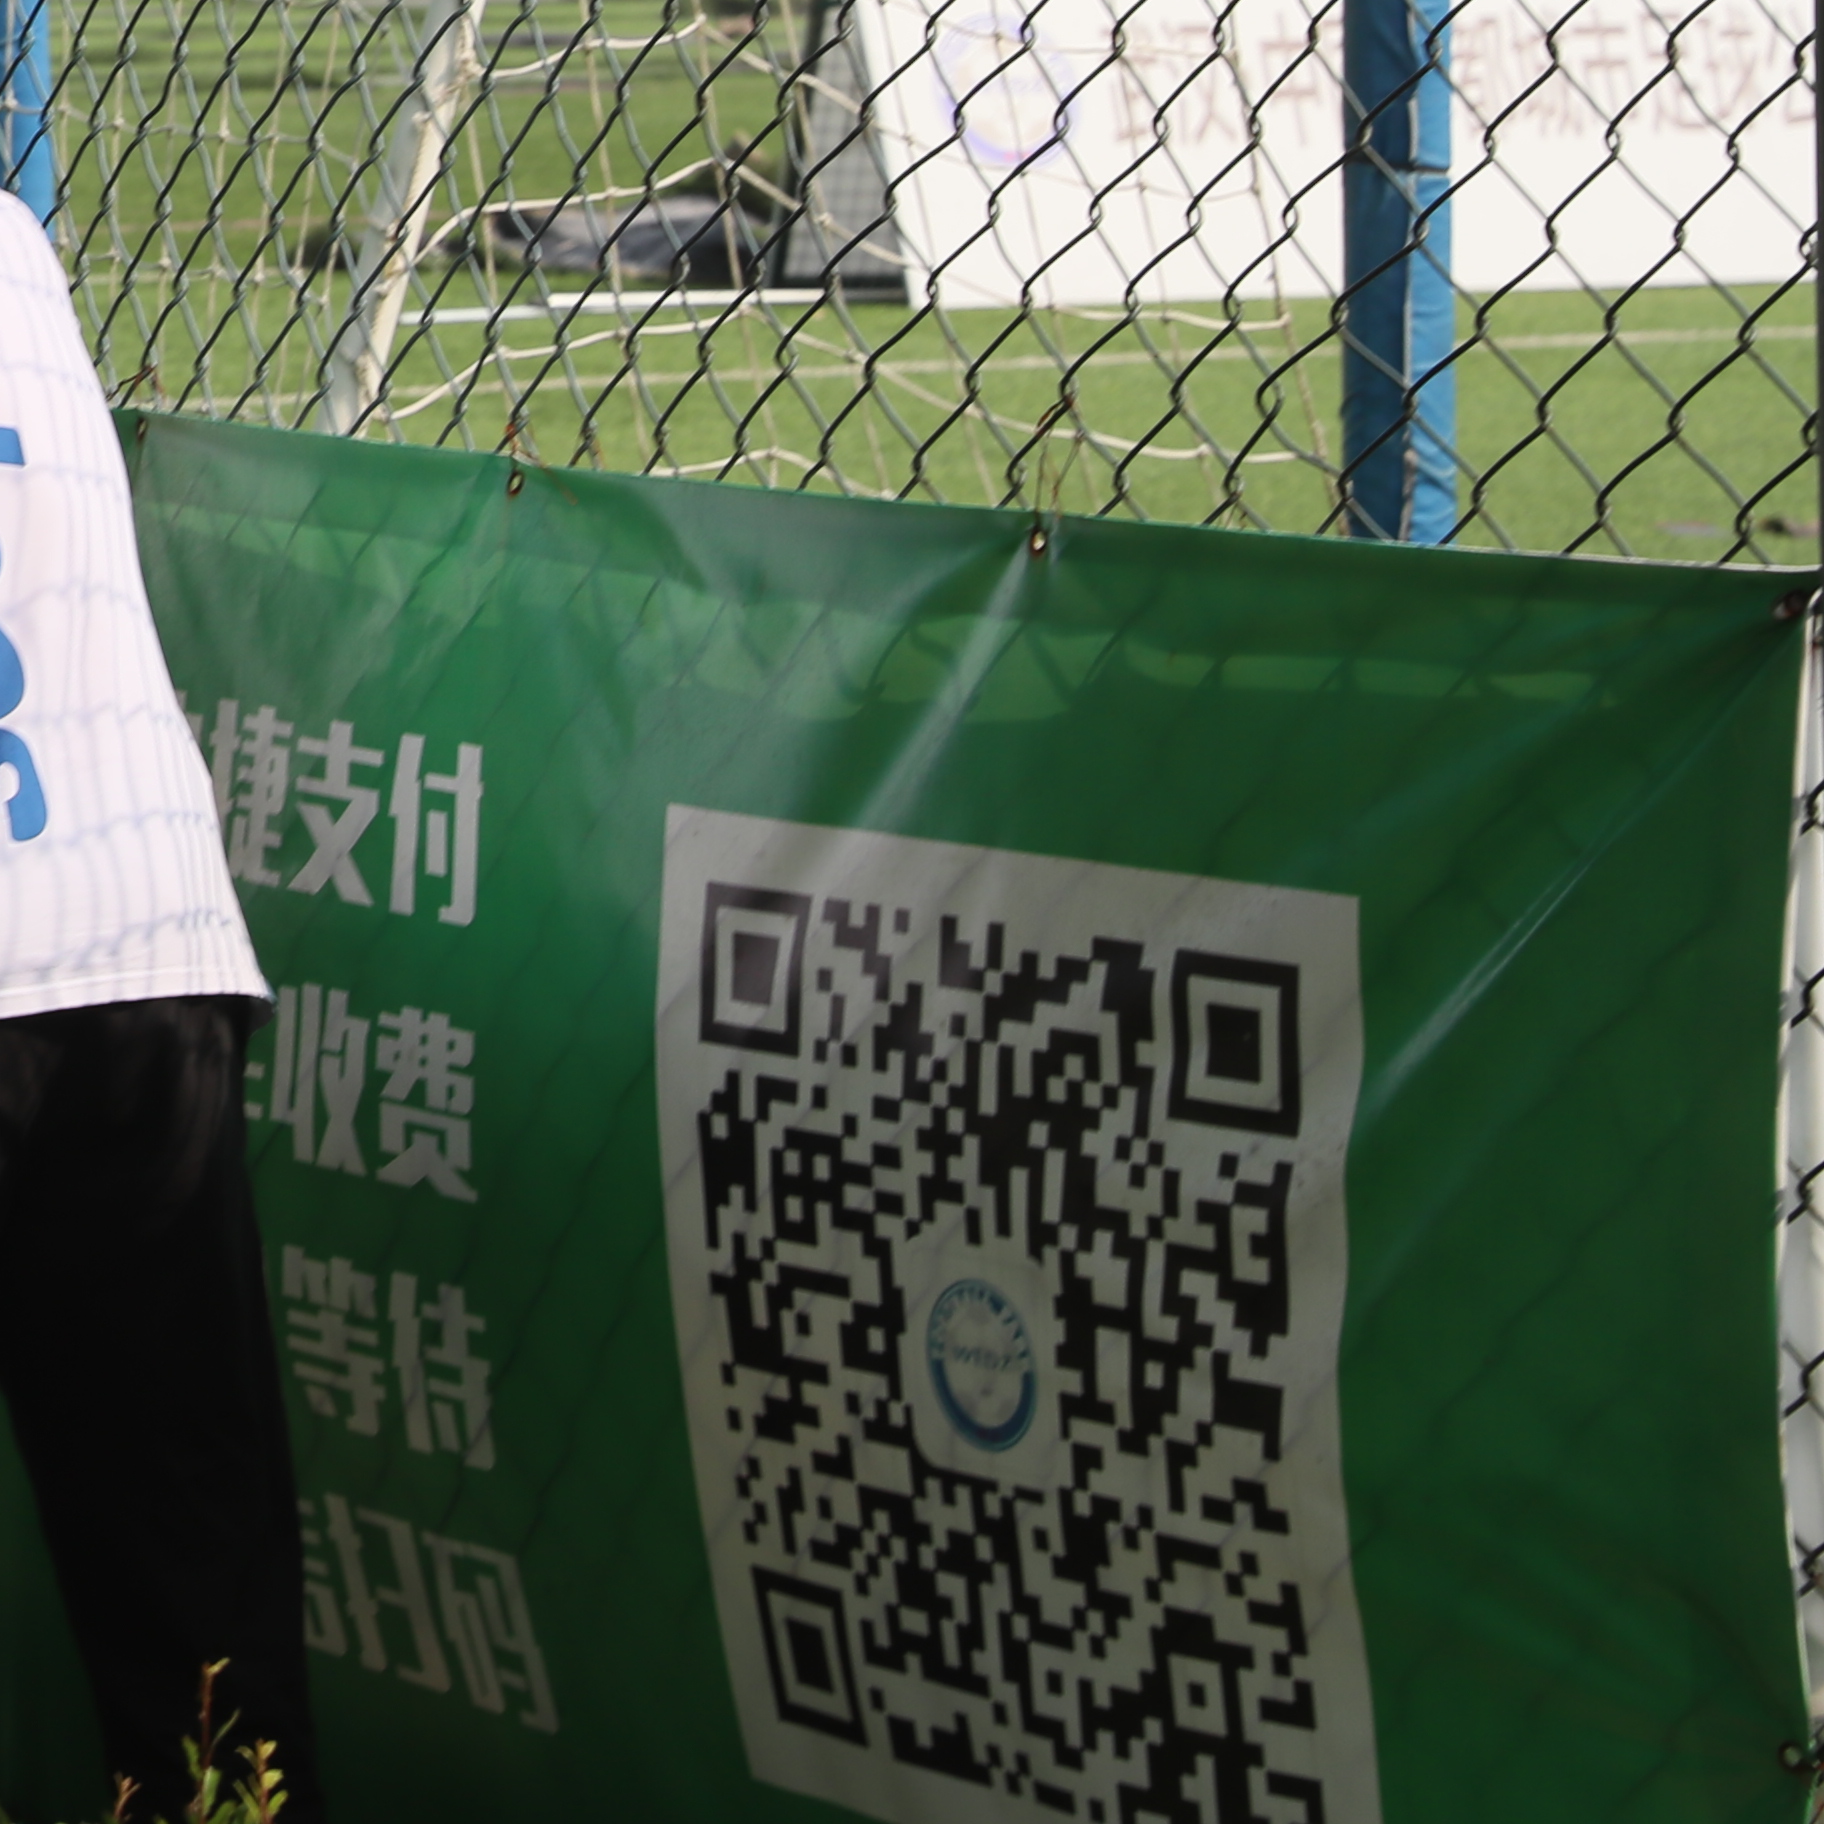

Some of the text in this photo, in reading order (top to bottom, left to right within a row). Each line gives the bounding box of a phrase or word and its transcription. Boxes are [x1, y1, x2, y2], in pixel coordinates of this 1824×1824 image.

[176, 689, 483, 928] 捷支付
[243, 982, 479, 1204] 收费
[281, 1243, 496, 1472] 等待
